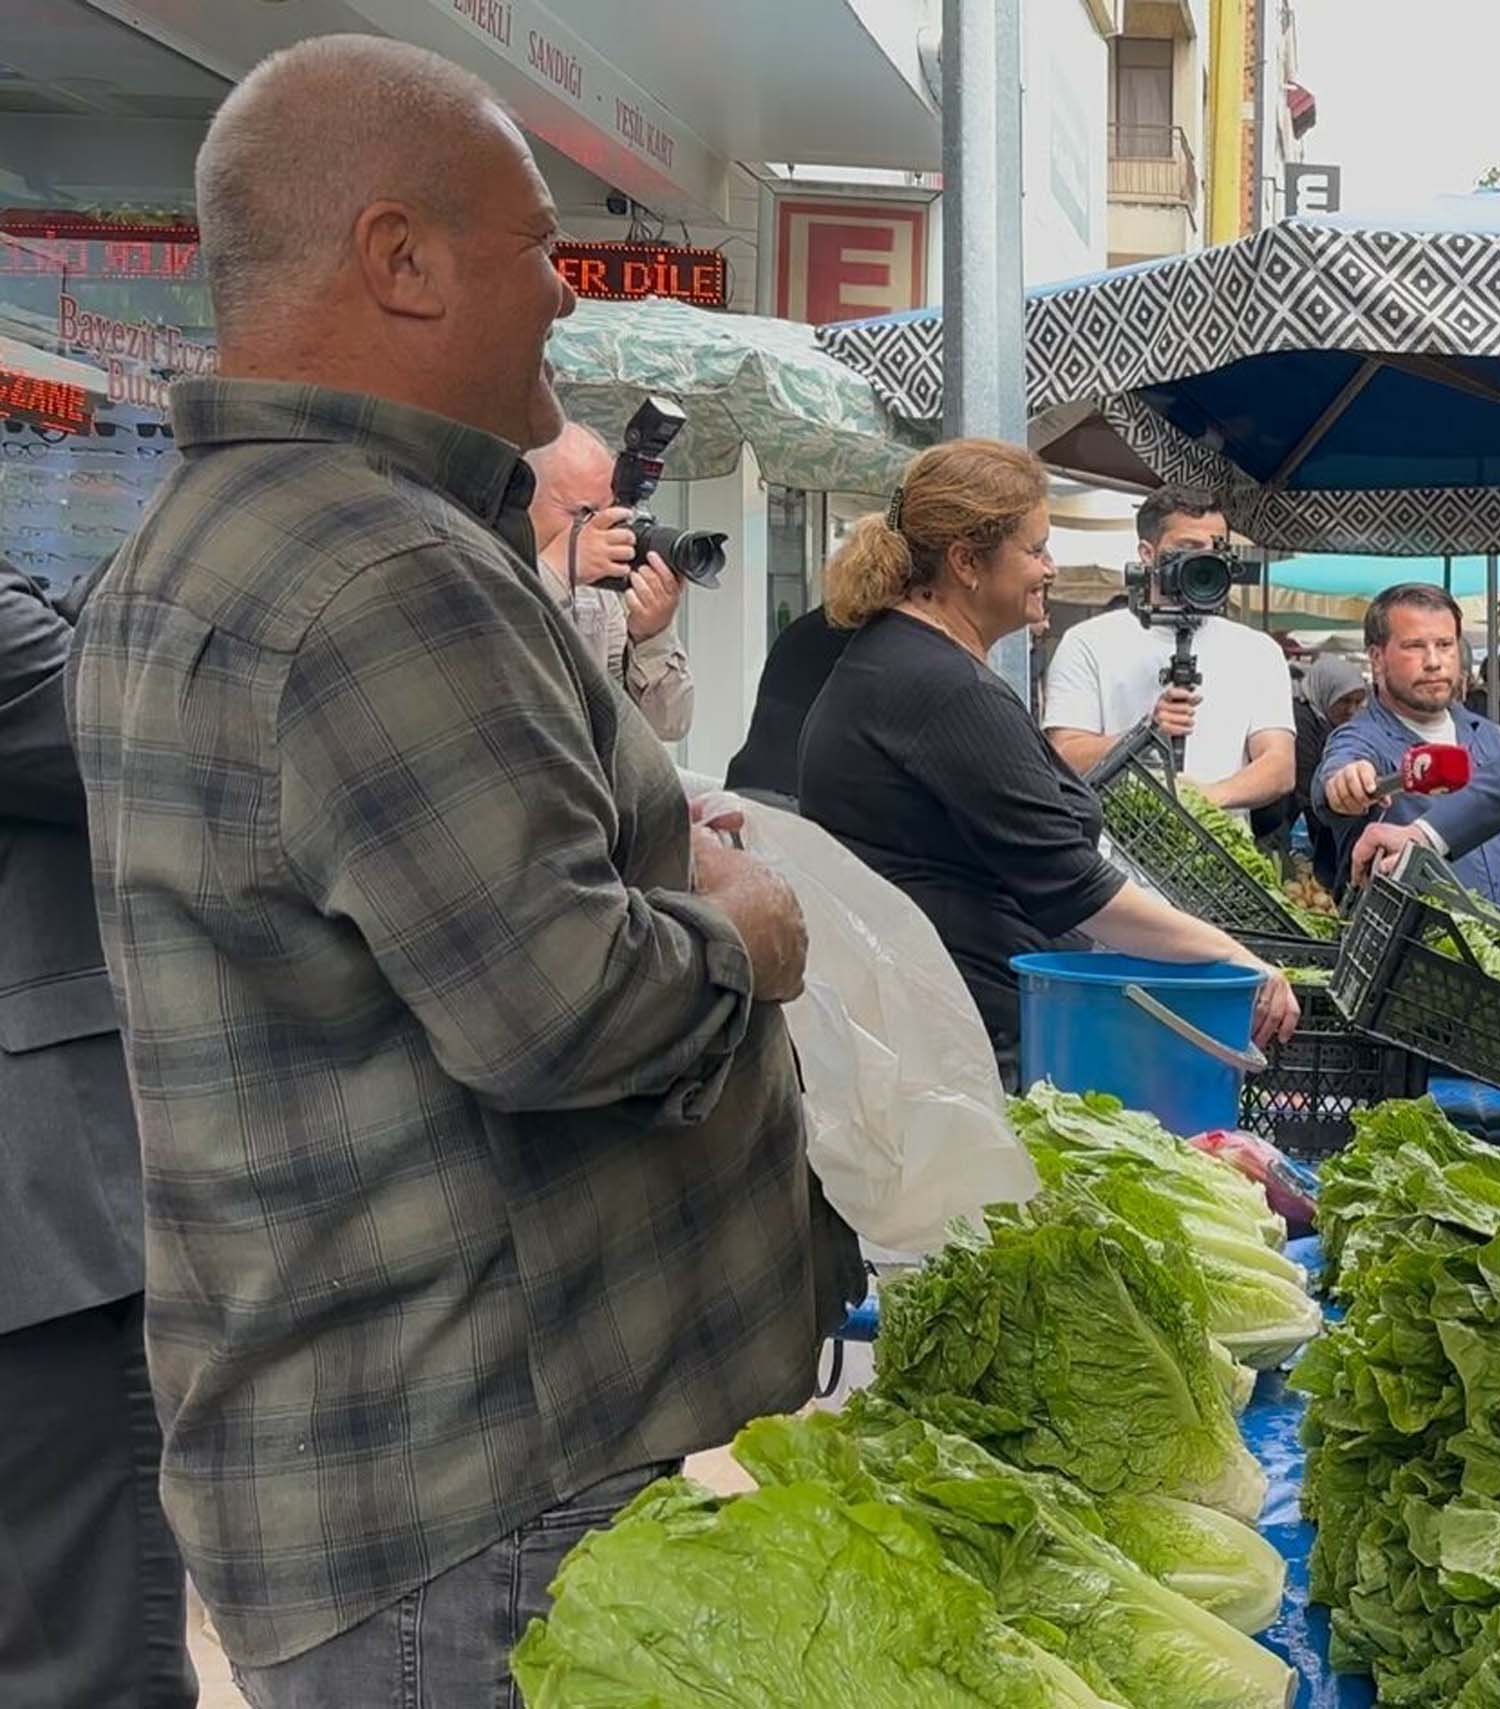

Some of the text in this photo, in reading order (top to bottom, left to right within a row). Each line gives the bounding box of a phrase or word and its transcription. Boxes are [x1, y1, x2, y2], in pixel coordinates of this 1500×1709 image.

[454, 0, 513, 46] MEKLİ
[528, 30, 583, 98] SANDIĞI
[623, 253, 715, 297] DİLE
[806, 222, 894, 325] E
[59, 293, 160, 363] Bayezit
